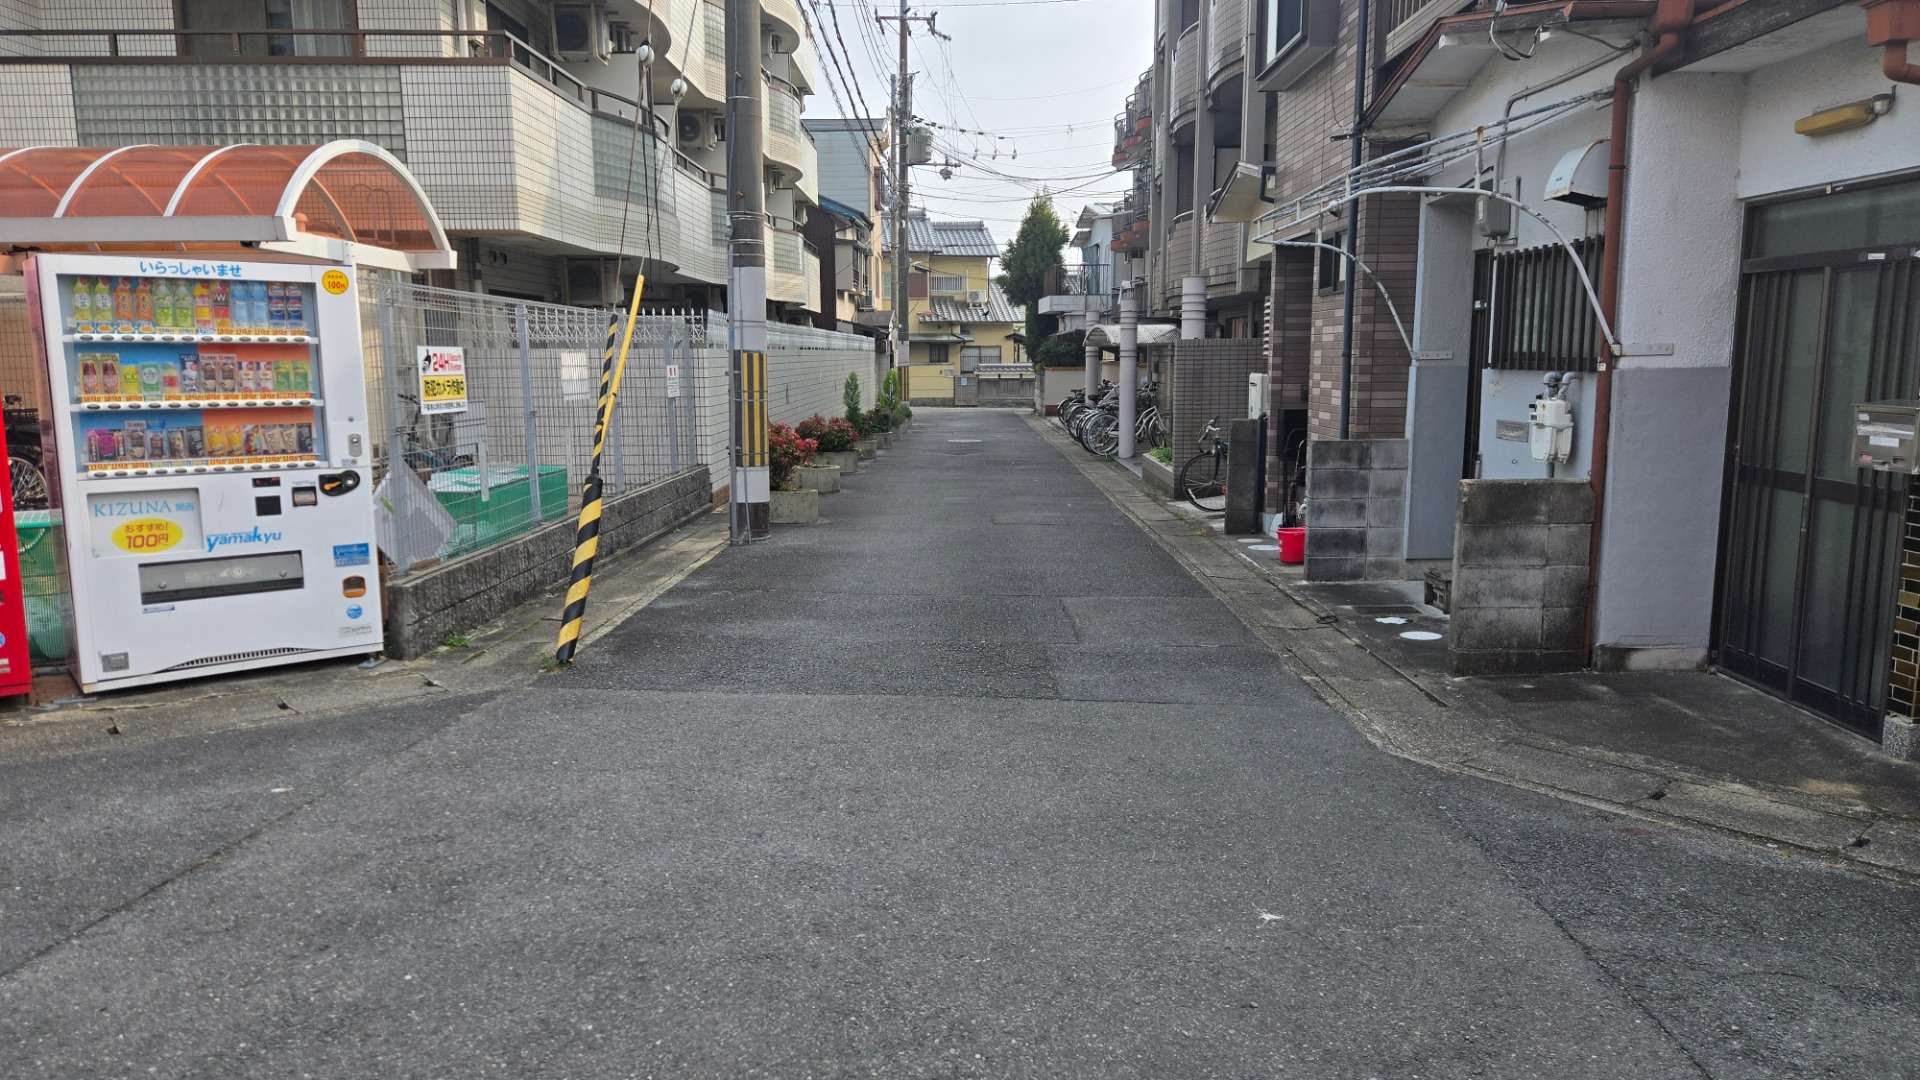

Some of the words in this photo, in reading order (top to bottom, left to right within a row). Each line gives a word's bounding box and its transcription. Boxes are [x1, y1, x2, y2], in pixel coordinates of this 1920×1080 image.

[140, 261, 242, 277] いらっしゃいませ
[93, 500, 172, 517] KIZUNA
[126, 534, 169, 550] 100円
[206, 526, 283, 553] yamakyu
